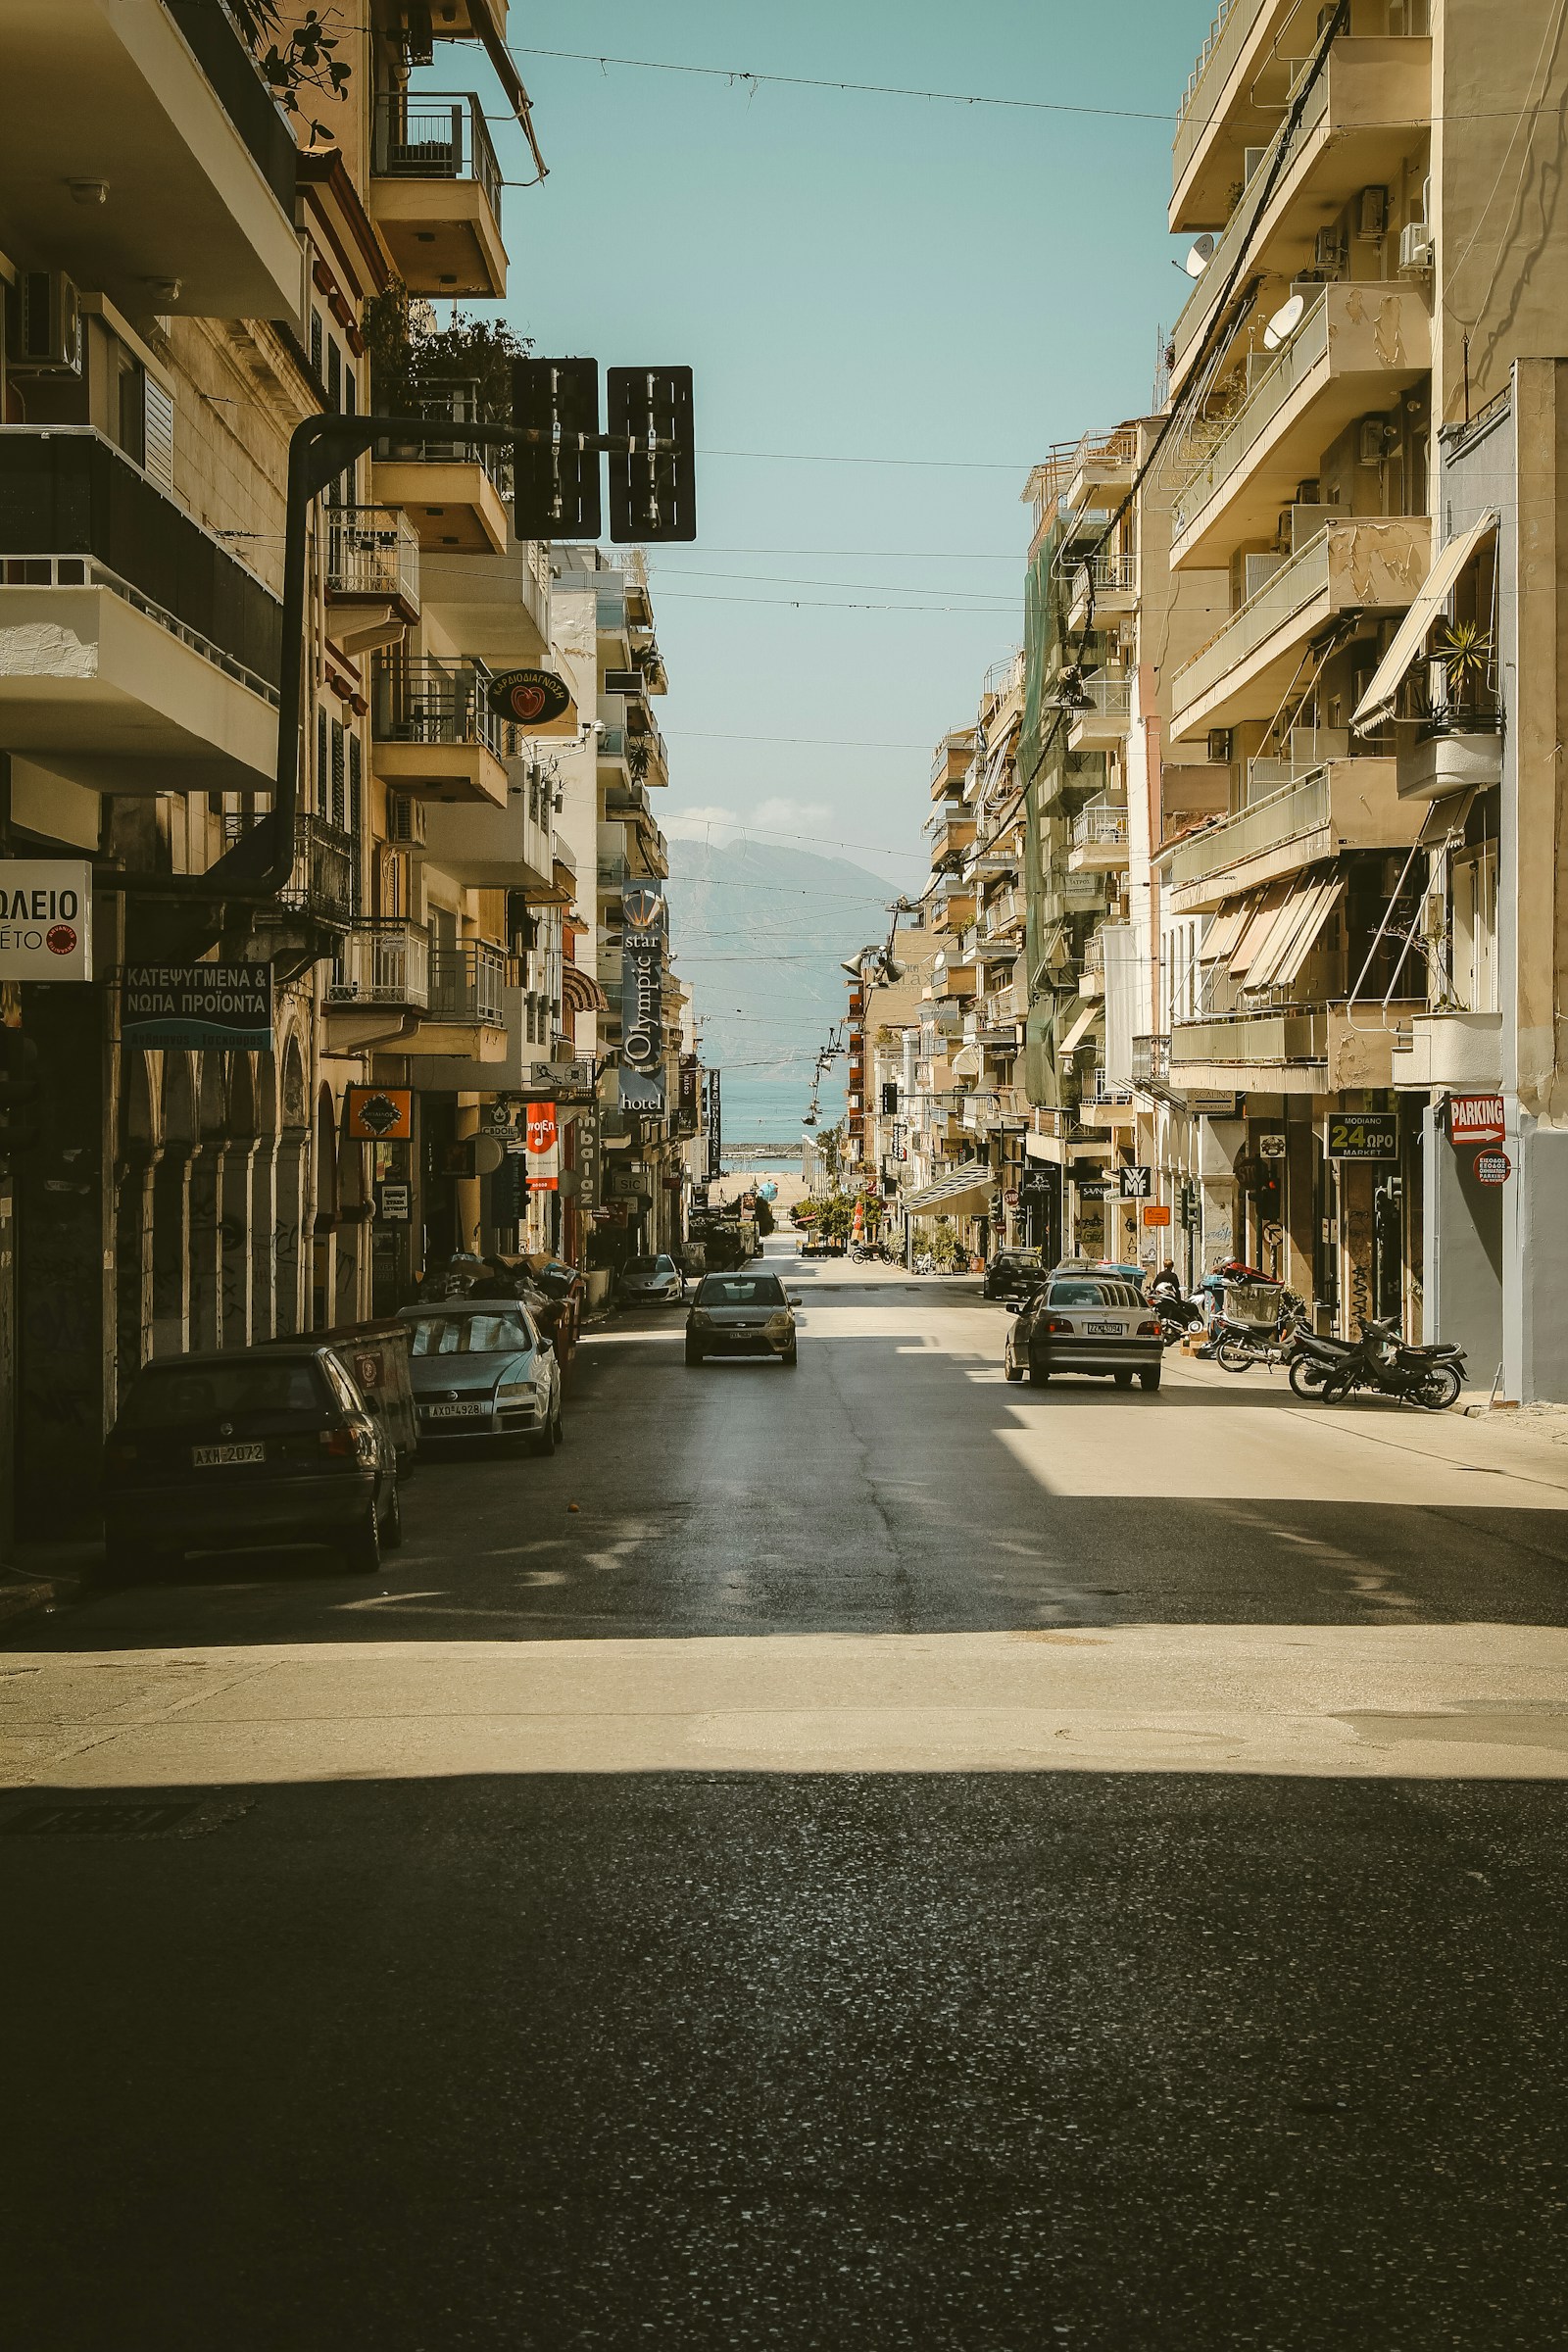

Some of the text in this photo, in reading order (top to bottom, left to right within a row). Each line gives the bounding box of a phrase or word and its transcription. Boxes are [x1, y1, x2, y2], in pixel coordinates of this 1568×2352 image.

[493, 673, 565, 699] ΚΑΡΔΙΟΔΙΑΓΝΩΣΗ
[625, 933, 659, 948] star
[127, 968, 267, 987] ΚΑΤΕΨΥΓΜΕΝΑ &
[127, 990, 266, 1012] ΝΩΠΑ ΠΡΟΪΟΝΤΑ
[624, 956, 659, 1060] Olympic
[622, 1093, 663, 1109] hotel
[1451, 1100, 1503, 1126] PARKING
[1004, 1193, 1019, 1202] STOP
